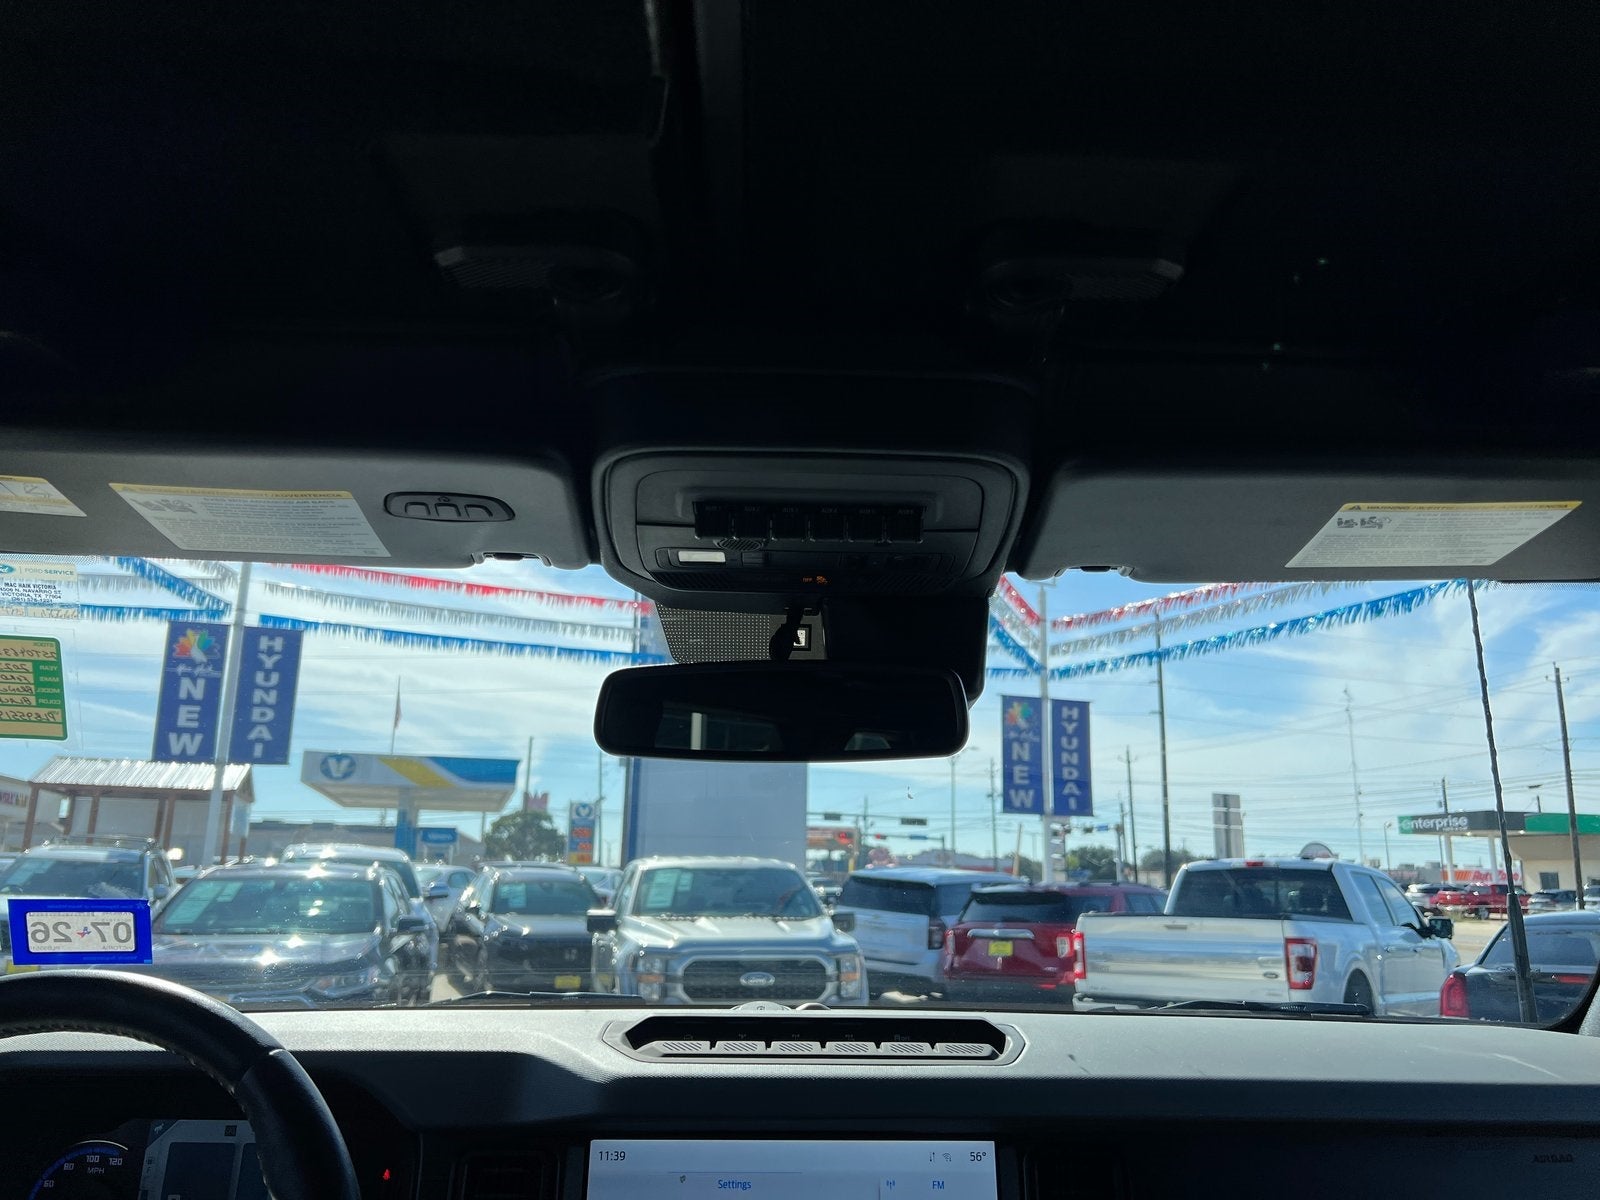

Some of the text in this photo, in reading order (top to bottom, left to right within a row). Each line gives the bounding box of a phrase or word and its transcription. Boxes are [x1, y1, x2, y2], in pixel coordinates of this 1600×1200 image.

[246, 635, 284, 759] HYUNDAI
[168, 676, 206, 757] NEW
[1060, 705, 1081, 810] HYUNDAI
[1008, 741, 1035, 809] NEW
[1401, 815, 1469, 831] enterprise
[87, 1155, 100, 1163] 100
[109, 1157, 123, 1166] 120
[599, 1151, 987, 1162] 11:39 56°
[63, 1163, 75, 1171] 80
[43, 1180, 55, 1188] 60
[718, 1179, 752, 1191] Settings
[932, 1180, 945, 1190] FM
